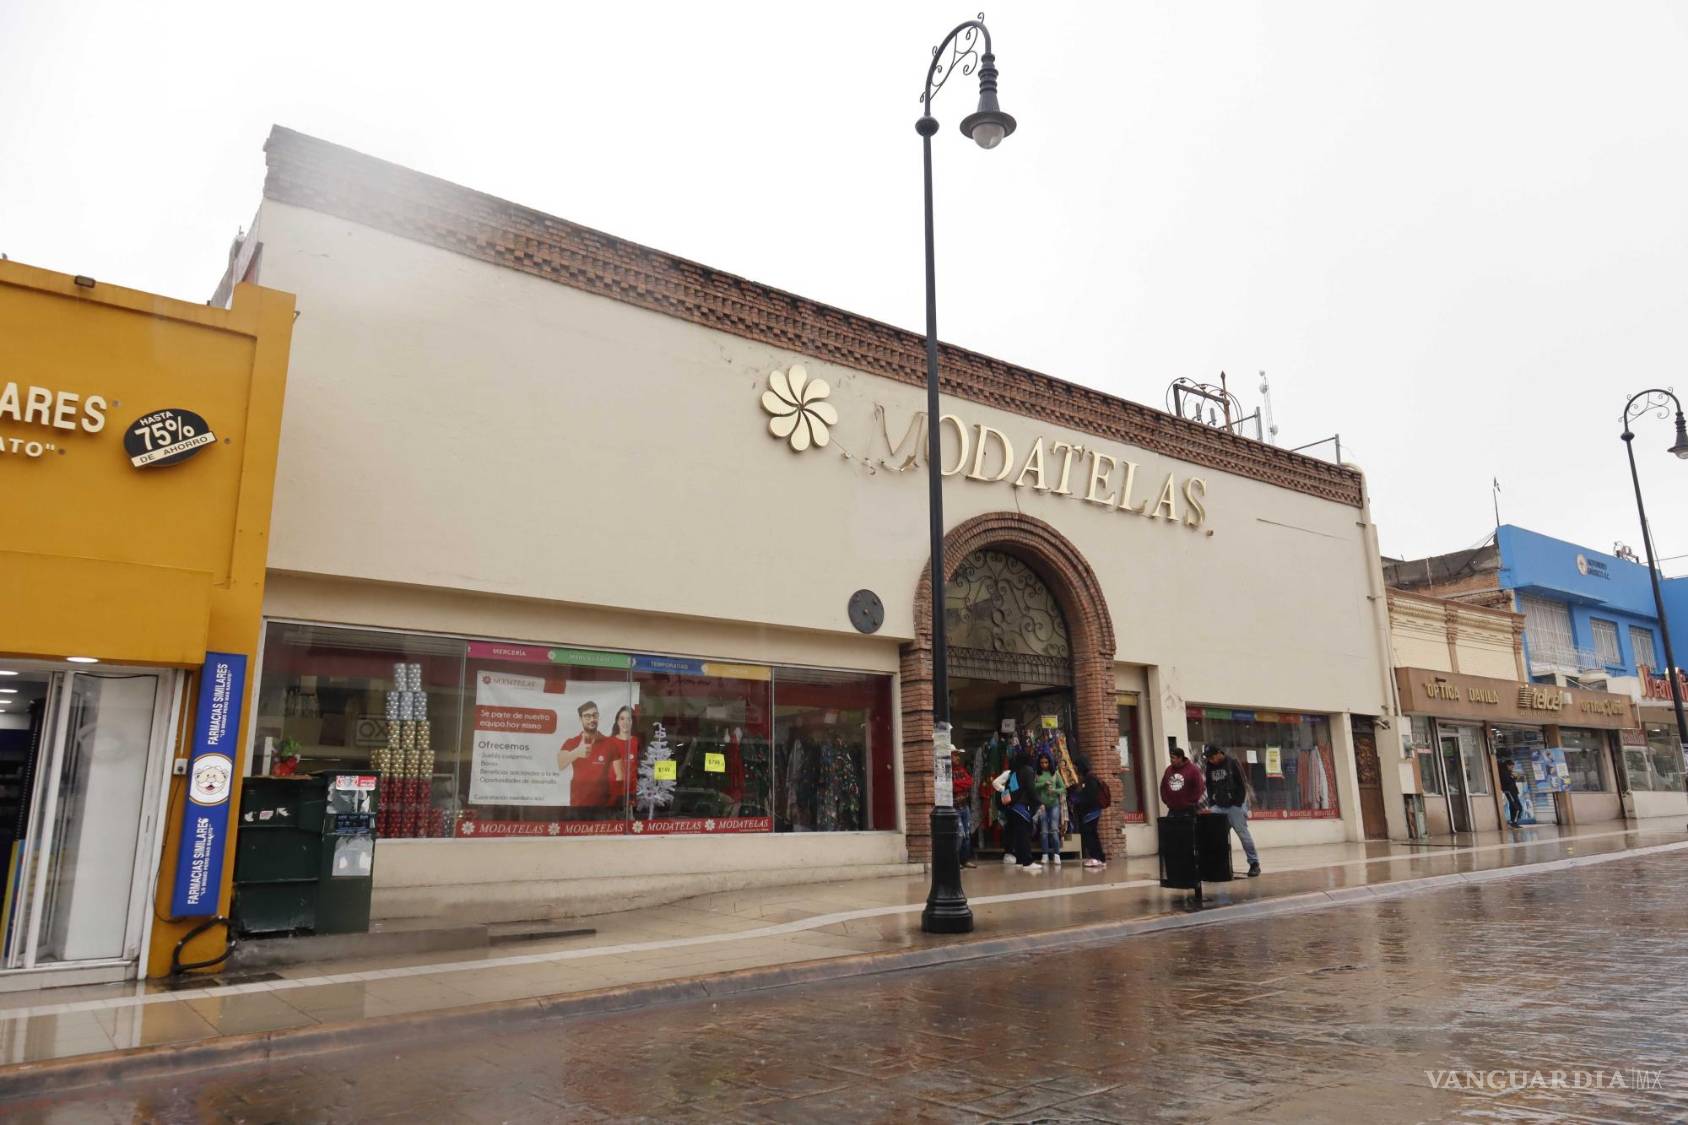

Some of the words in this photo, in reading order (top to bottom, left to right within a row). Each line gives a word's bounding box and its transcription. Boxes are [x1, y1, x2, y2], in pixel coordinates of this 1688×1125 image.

[134, 415, 195, 450] 75%
[140, 411, 174, 426] HASTA
[140, 453, 155, 464] DE
[163, 436, 208, 456] AHORRO
[213, 663, 228, 703] SIMILARES
[207, 703, 223, 745] FARMACIAS
[513, 711, 523, 719] de
[193, 817, 209, 859] SIMILARES
[479, 823, 545, 834] MODATELAS
[564, 822, 625, 833] MODATELAS
[647, 820, 701, 831] MODATELAS
[718, 819, 769, 830] MODATELAS
[187, 860, 204, 905] FARMACIAS
